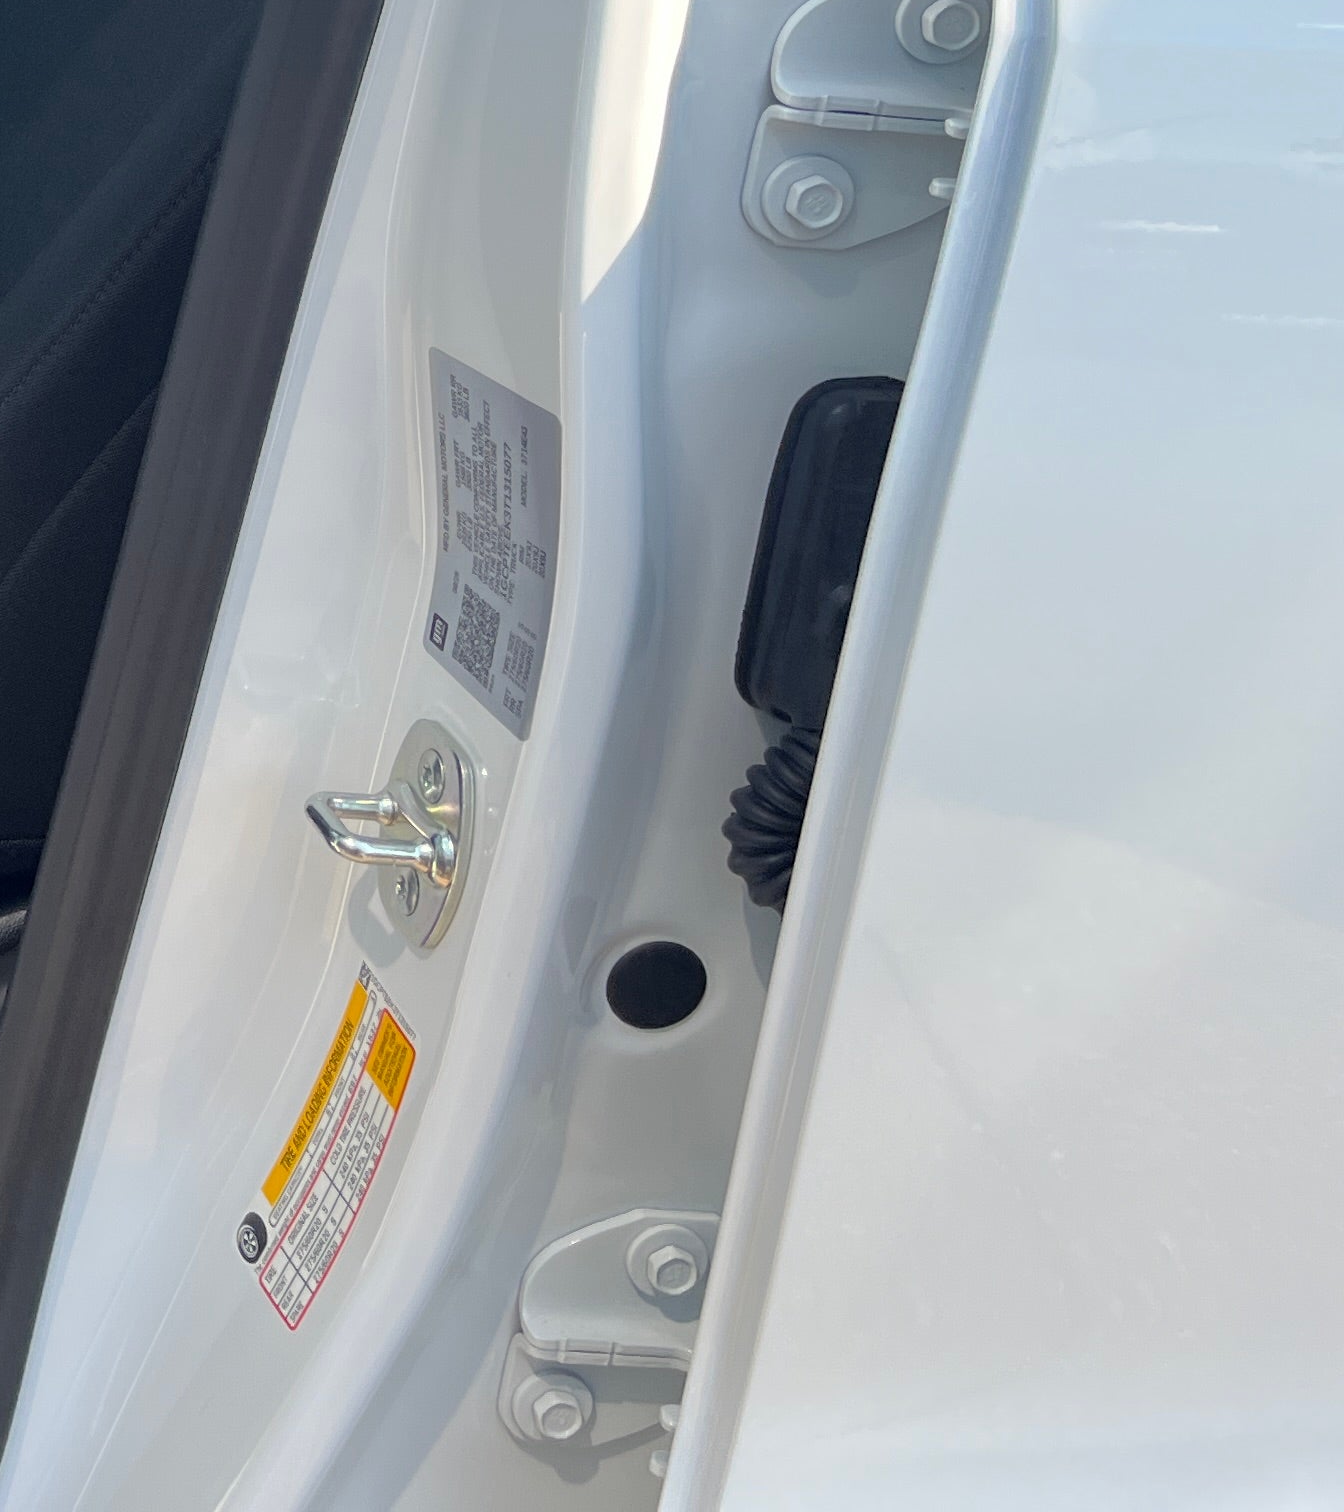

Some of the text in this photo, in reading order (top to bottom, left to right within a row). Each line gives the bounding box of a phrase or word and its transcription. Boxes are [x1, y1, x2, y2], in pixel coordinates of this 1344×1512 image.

[439, 430, 447, 473] MOTORS
[279, 1016, 354, 1175] TIRE AND LOADING INFORMATION
[329, 1140, 342, 1166] COLD
[286, 1191, 318, 1247] ORIGINAL SIZE
